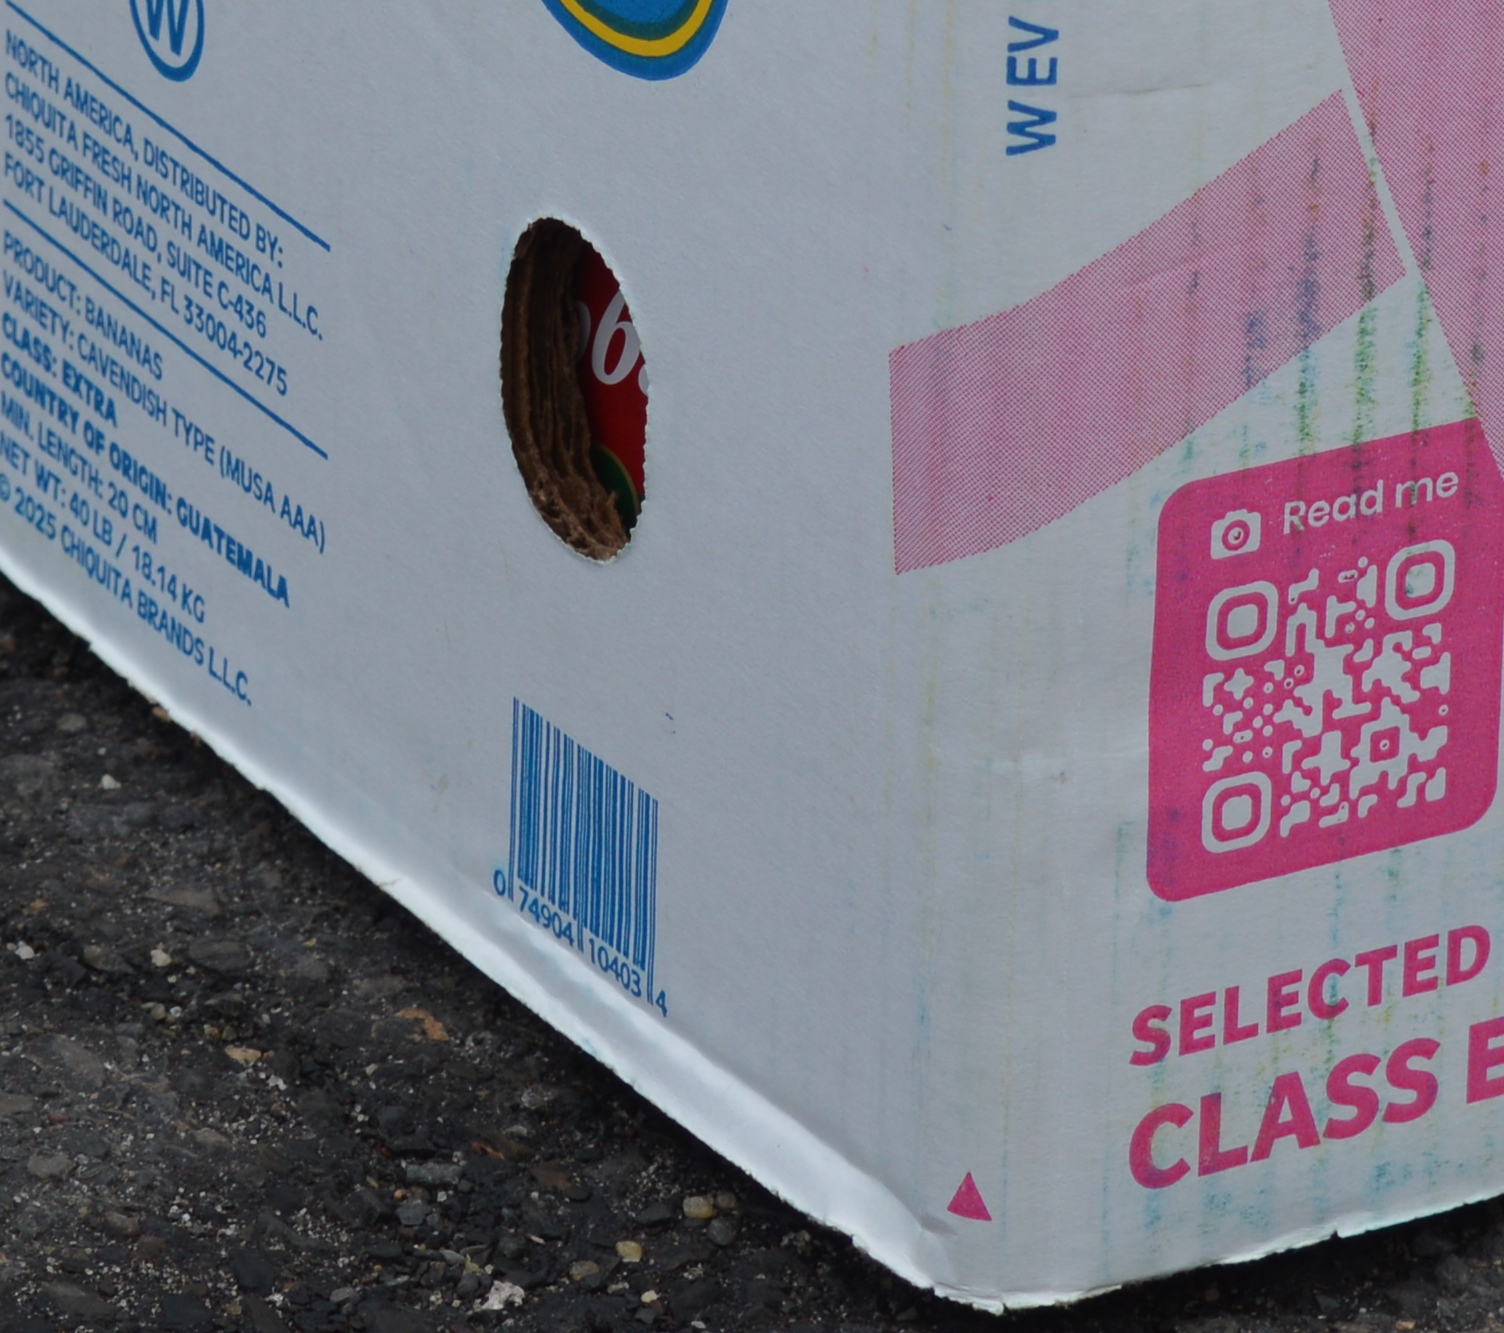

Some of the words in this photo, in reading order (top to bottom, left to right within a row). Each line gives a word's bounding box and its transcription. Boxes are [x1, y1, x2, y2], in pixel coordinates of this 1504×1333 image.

[1004, 100, 1060, 158] W
[1006, 15, 1060, 92] EV
[4, 70, 79, 152] CHIQUITA
[82, 130, 133, 193] FRESH
[135, 174, 193, 241] NORTH
[196, 223, 274, 306] AMERICA
[277, 281, 324, 341] L.L.C.
[4, 113, 45, 165] 1855
[48, 147, 108, 217] GRIFFIN
[111, 196, 162, 264] ROAD,
[165, 240, 214, 300] SUITE
[216, 281, 267, 339] C-436
[5, 28, 59, 94] NORTH
[63, 76, 140, 163] AMERICA,
[143, 136, 251, 241] DISTRIBUTED
[255, 219, 284, 269] BY:
[2, 229, 82, 316] PRODUCT:
[84, 296, 164, 382] BANANAS
[3, 151, 46, 205] FORT
[48, 186, 157, 302] LAUDERDALE,
[160, 275, 181, 316] FL
[182, 293, 289, 397] 33004-2275
[1, 312, 58, 379] CLASS:
[61, 358, 119, 429] EXTRA
[2, 269, 75, 351] VARIETY:
[77, 332, 168, 428] CAVENDISH
[171, 407, 216, 466] TYPE
[219, 445, 276, 513] (MUSA
[279, 495, 326, 555] AAA)
[0, 390, 34, 441] MIN.
[37, 420, 104, 497] LENGTH:
[107, 481, 130, 519] 20
[132, 503, 158, 545] CM
[0, 351, 80, 436] COUNTRY
[82, 415, 108, 457] OF
[108, 441, 174, 515] ORIGIN:
[175, 496, 291, 610] GUATEMALA
[32, 461, 67, 506] WT:
[68, 491, 91, 527] 40
[92, 509, 114, 547] LB
[114, 532, 128, 559] /
[131, 545, 179, 604] 18.14
[180, 582, 206, 625] KG
[1281, 477, 1386, 537] Read
[1394, 469, 1461, 510] me
[14, 486, 57, 542] 2025
[60, 524, 134, 610] CHIQUITA
[136, 588, 205, 668] BRANDS
[207, 646, 253, 708] L.L.C.
[492, 868, 507, 897] 0
[517, 884, 576, 949] 74904
[588, 936, 643, 999] 10403
[654, 989, 669, 1019] 4
[1127, 923, 1492, 1067] SELECTED
[1126, 1036, 1442, 1191] CLASS
